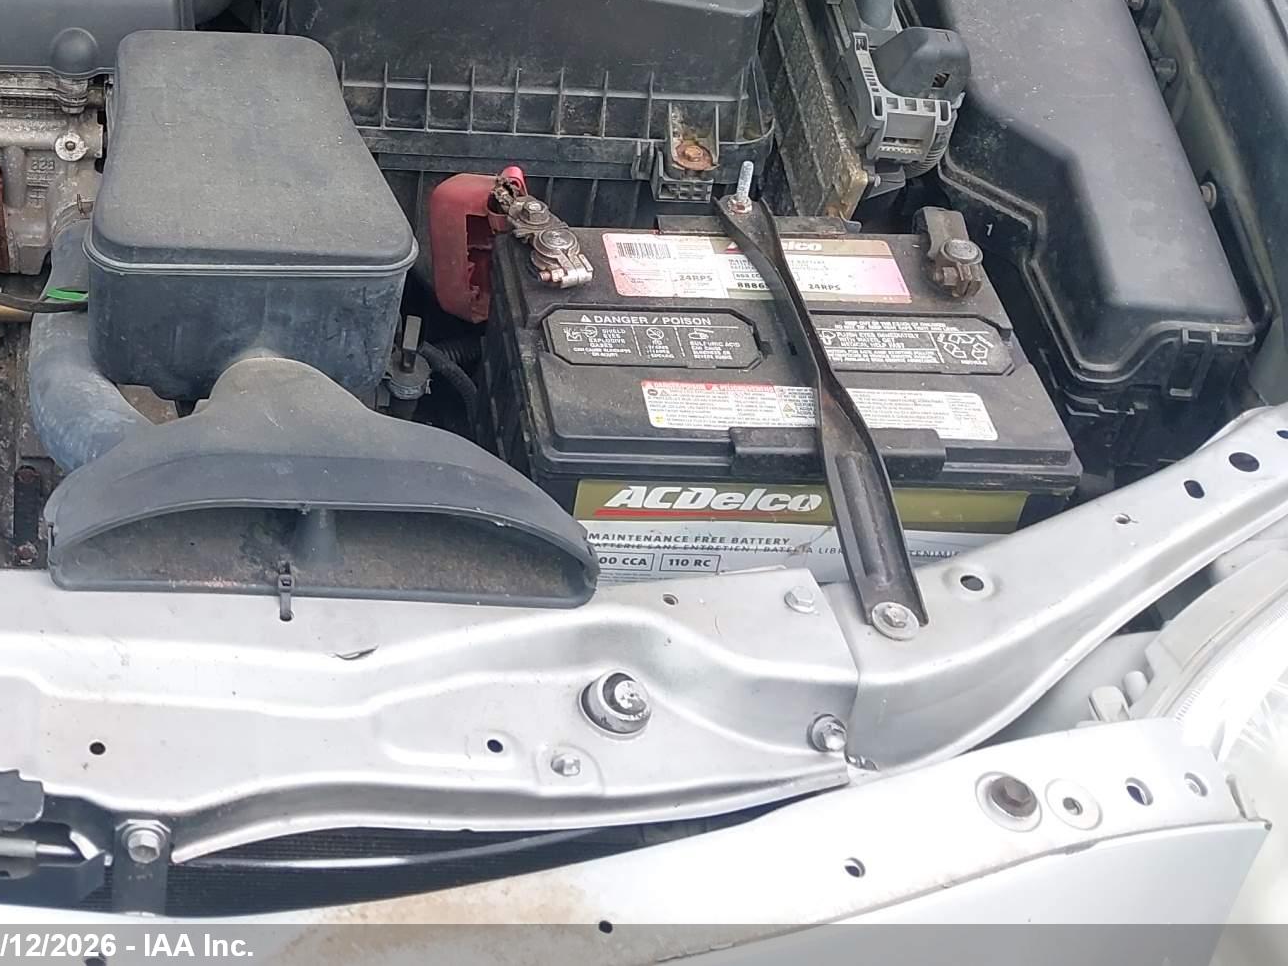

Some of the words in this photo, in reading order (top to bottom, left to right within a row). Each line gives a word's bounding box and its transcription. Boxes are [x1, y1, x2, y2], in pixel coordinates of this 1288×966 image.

[594, 315, 649, 325] DANGER
[651, 317, 658, 325] /
[661, 316, 712, 326] POISON
[603, 485, 823, 512] ACDelco
[588, 532, 689, 544] MAINTENANCE
[694, 535, 726, 544] FREE
[732, 536, 791, 546] BATTERY
[598, 556, 620, 565] 00
[622, 557, 647, 566] CCA
[669, 558, 688, 567] 110
[694, 558, 711, 567] RC
